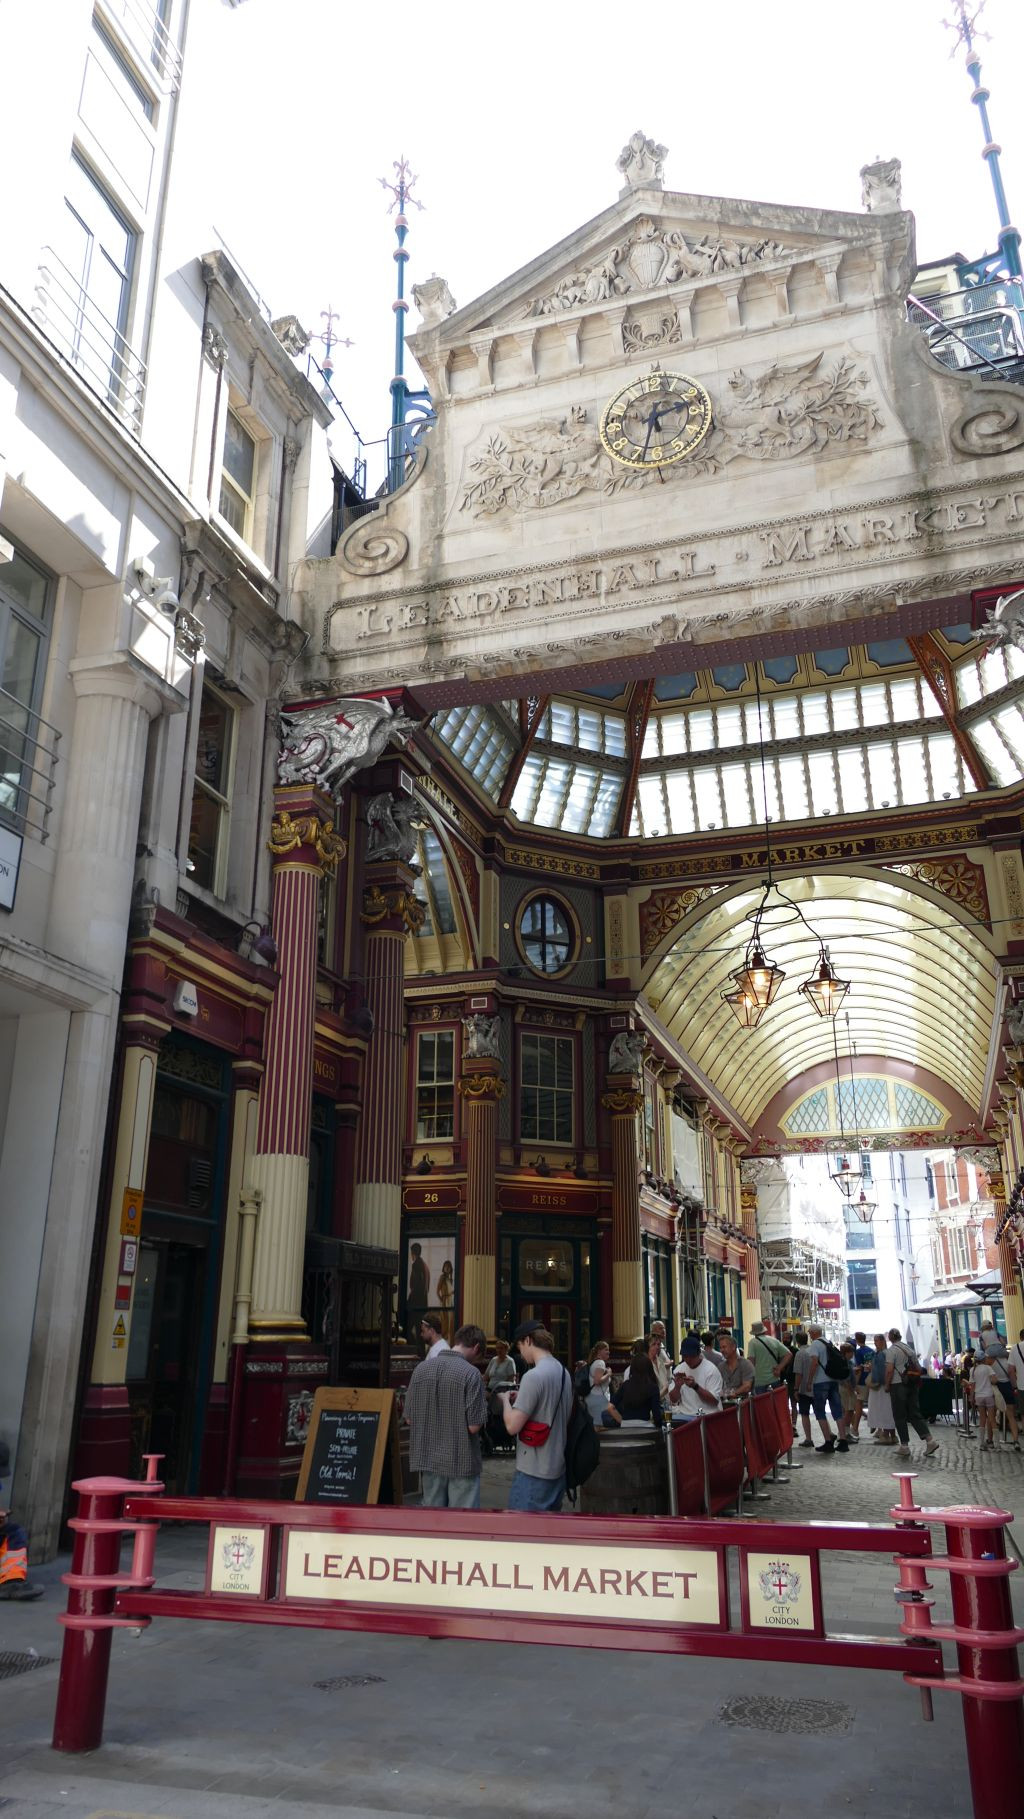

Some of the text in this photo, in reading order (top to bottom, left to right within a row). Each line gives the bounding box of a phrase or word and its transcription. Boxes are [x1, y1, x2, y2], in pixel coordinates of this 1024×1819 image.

[644, 377, 661, 392] 12
[668, 379, 679, 392] 1
[627, 386, 641, 401] 11
[681, 387, 698, 401] 2
[610, 401, 627, 417] 10
[688, 405, 705, 416] 3
[606, 422, 622, 433] 9
[685, 424, 701, 436] 4
[612, 437, 628, 451] 8
[671, 438, 685, 452] 5
[630, 446, 645, 461] 7
[651, 446, 663, 461] 6
[357, 489, 1024, 637] LEADENHALL MARKET
[740, 839, 866, 868] MARKET
[424, 1193, 439, 1203] 26
[531, 1194, 567, 1206] REISS
[525, 1259, 568, 1272] REISS
[302, 1552, 698, 1600] LEADENHALL MARKET
[222, 1582, 250, 1591] LONDON
[772, 1605, 791, 1614] CITY
[765, 1616, 800, 1626] LONDON
